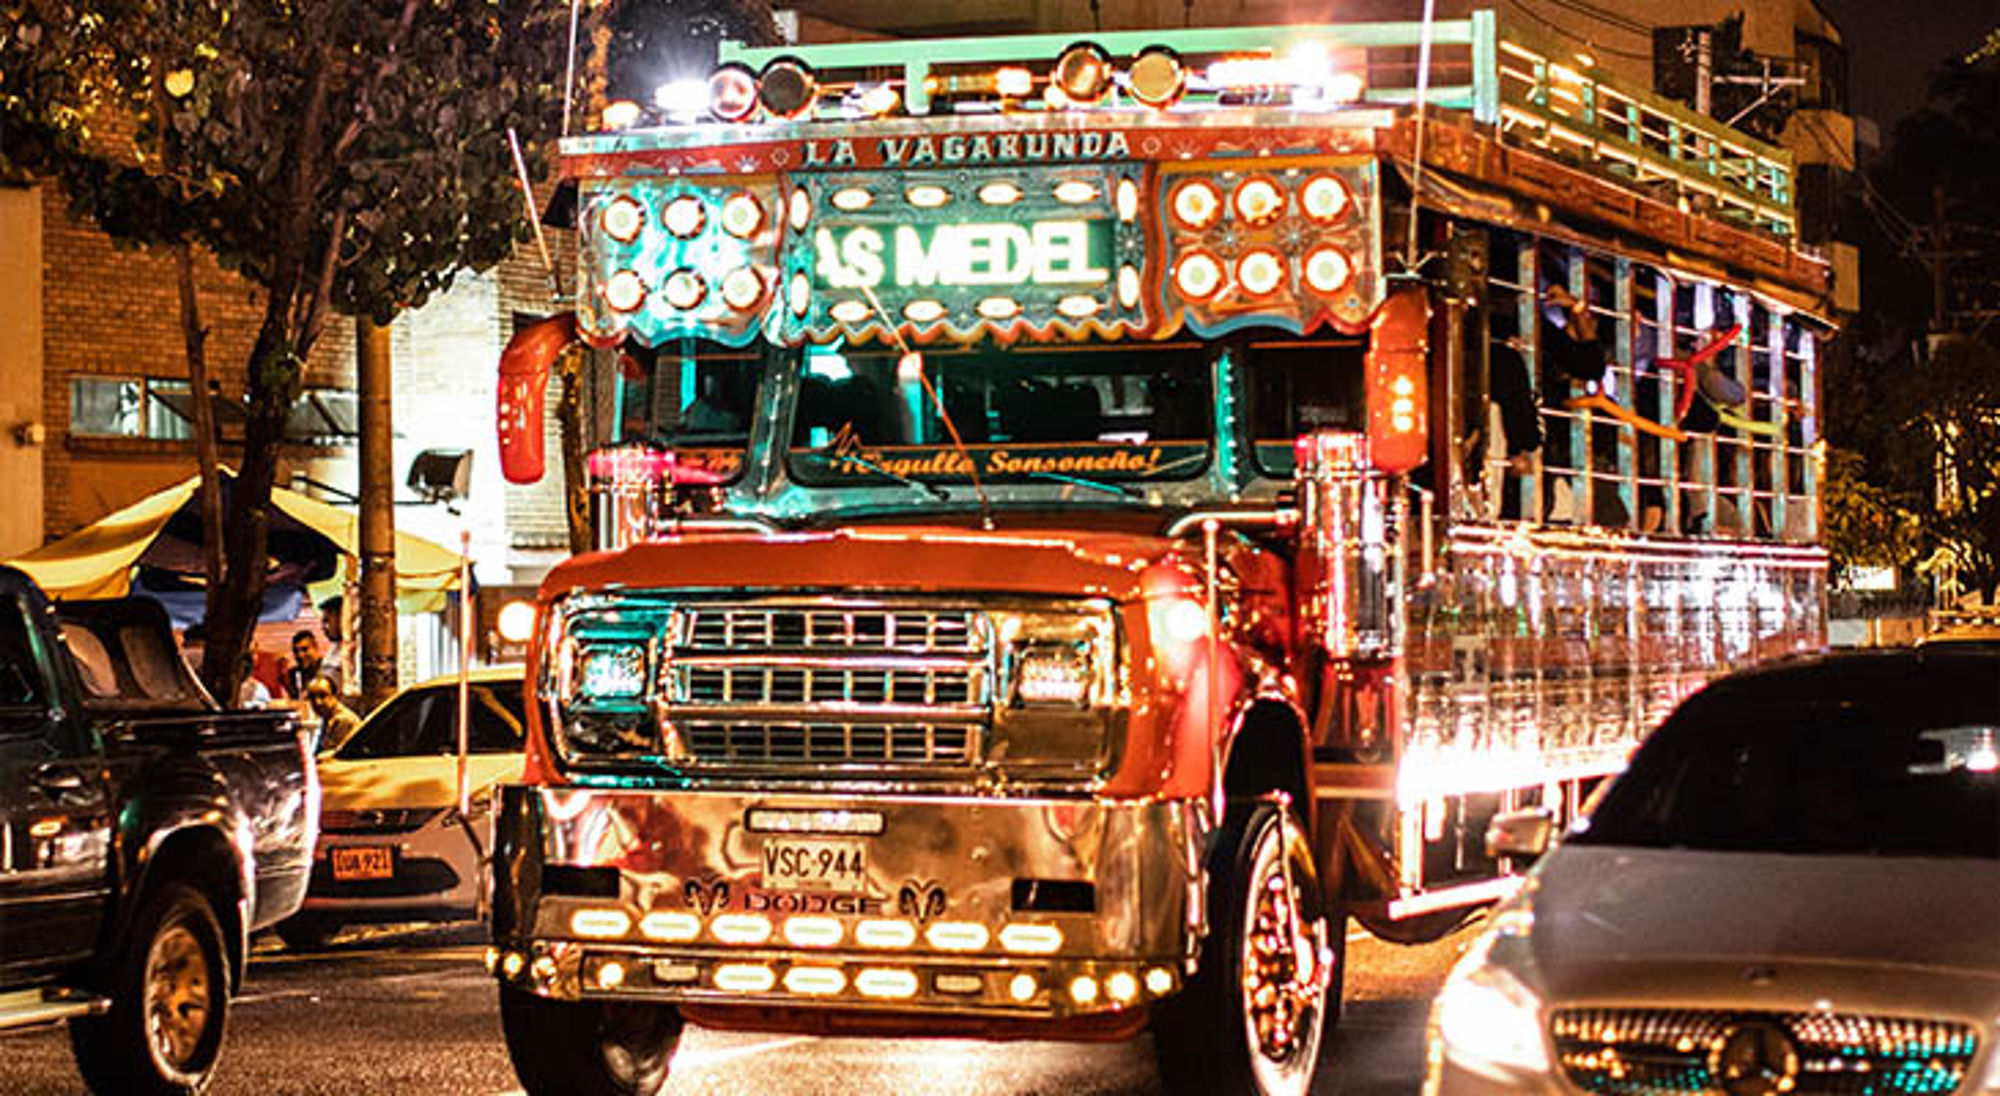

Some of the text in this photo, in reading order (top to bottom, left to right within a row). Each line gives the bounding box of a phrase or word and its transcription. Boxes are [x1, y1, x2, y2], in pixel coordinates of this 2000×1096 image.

[802, 139, 856, 167] LA
[895, 221, 1109, 286] MEDEL
[744, 895, 884, 914] DODGE
